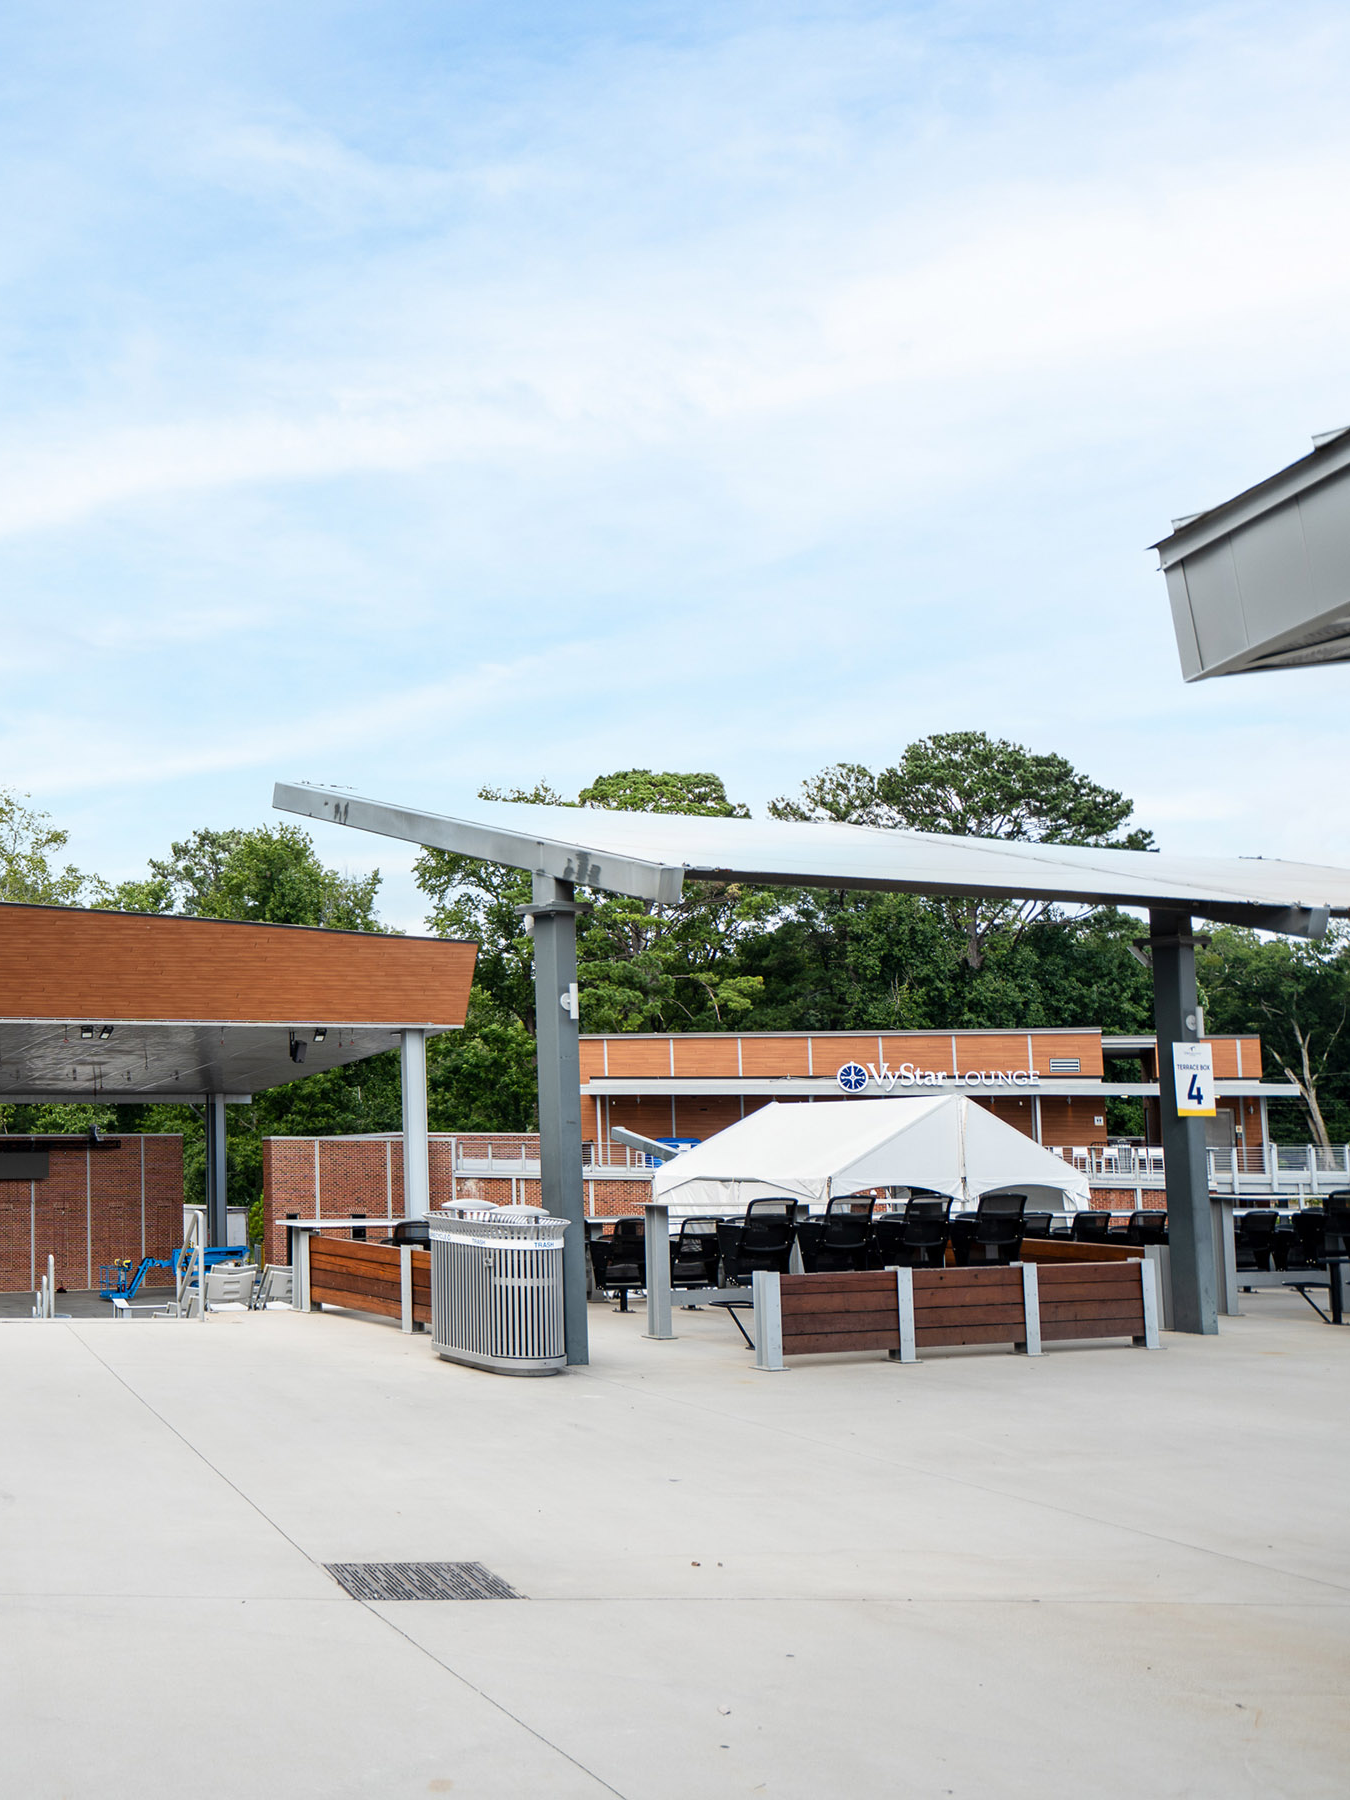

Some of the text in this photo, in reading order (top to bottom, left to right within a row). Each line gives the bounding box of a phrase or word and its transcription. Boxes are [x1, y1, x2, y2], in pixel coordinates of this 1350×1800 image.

[866, 1062, 1041, 1093] VyStar LOUNGE
[1187, 1073, 1204, 1105] 4
[534, 1241, 555, 1249] TRASH
